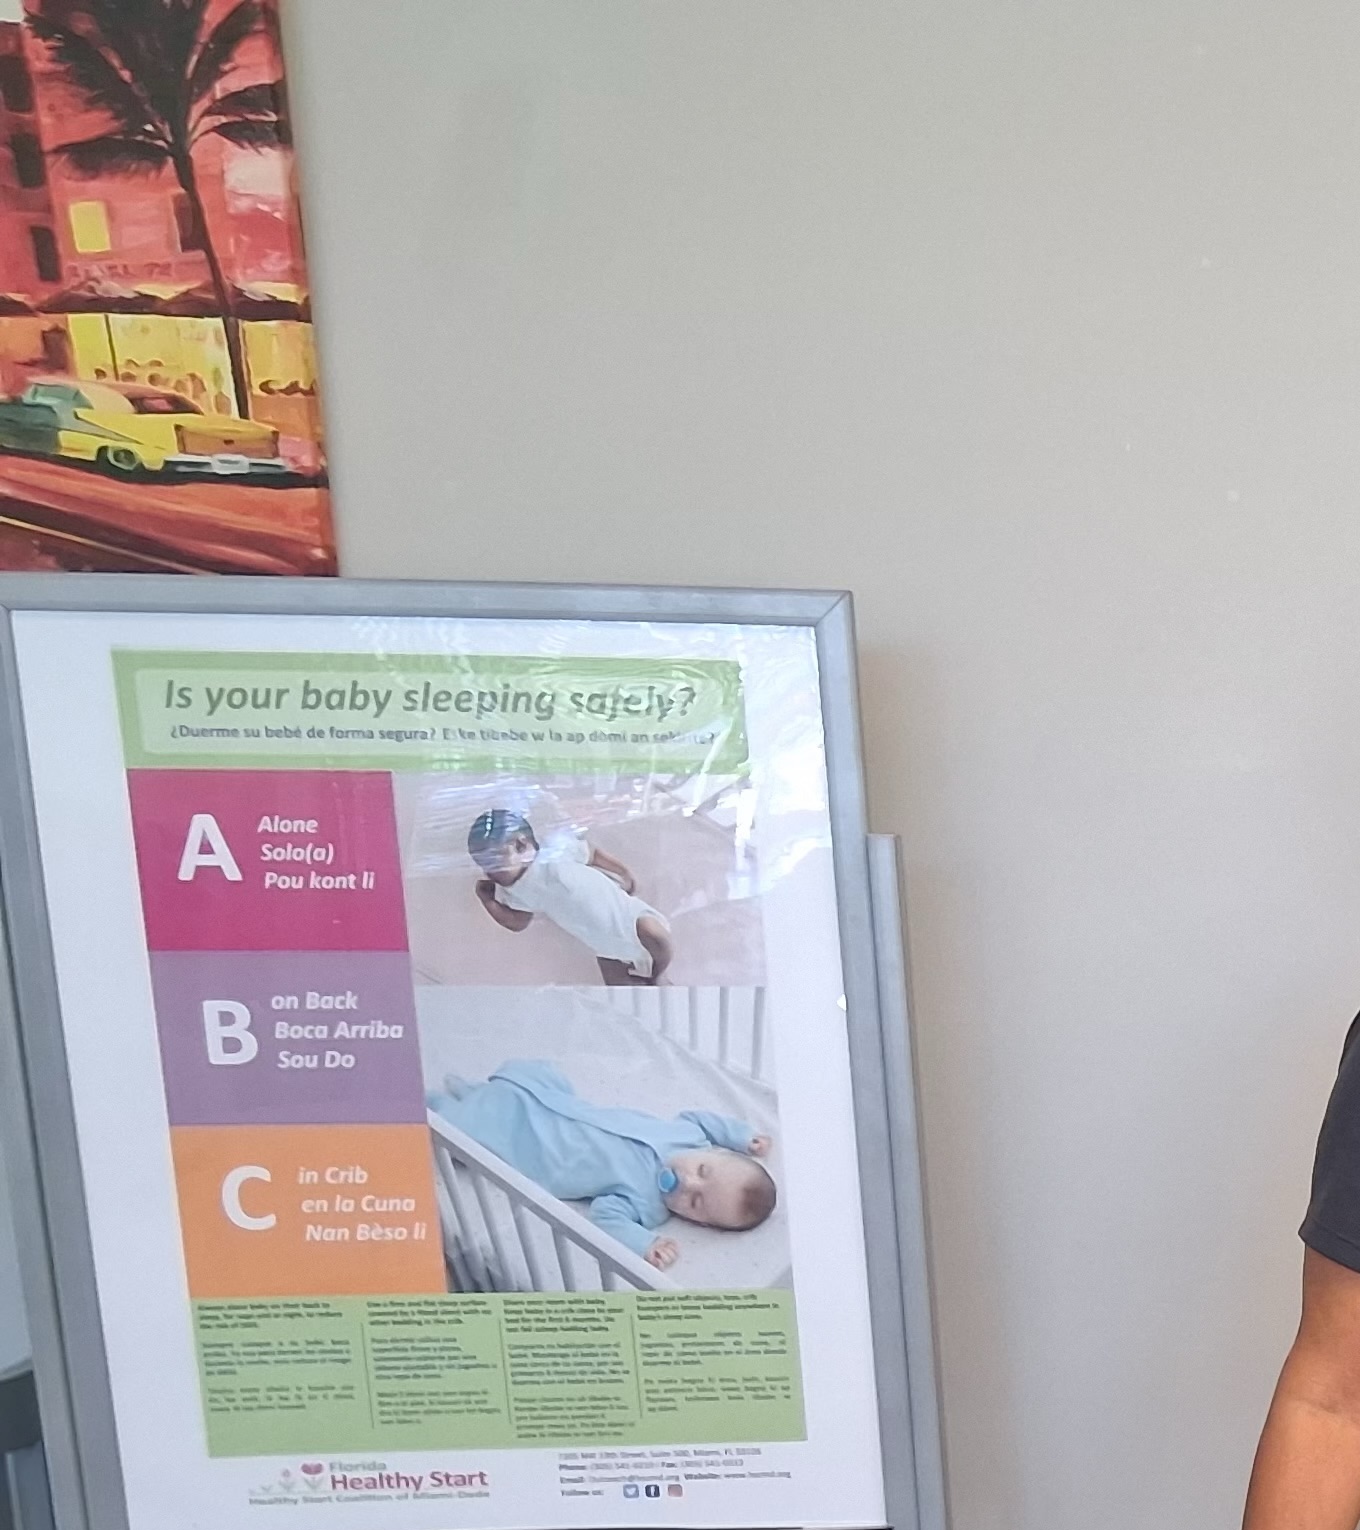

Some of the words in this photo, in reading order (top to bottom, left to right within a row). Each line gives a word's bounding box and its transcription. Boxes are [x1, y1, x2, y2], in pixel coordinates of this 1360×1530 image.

[165, 679, 193, 709] Is
[205, 686, 290, 717] your
[300, 679, 393, 719] baby
[403, 681, 556, 722] sleeping
[570, 684, 697, 723] safely?
[244, 728, 261, 739] su
[265, 725, 302, 739] bebé
[307, 726, 326, 740] de
[329, 726, 374, 740] forma
[378, 728, 436, 743] segura?
[257, 815, 319, 834] Alone
[178, 813, 243, 881] A
[260, 842, 335, 865] Solo(a)
[264, 872, 304, 889] Pou
[309, 871, 357, 889] kont
[362, 871, 375, 889] li
[271, 994, 299, 1010] on
[305, 991, 358, 1010] Back
[203, 1000, 259, 1065] B
[274, 1022, 329, 1039] Boca
[333, 1020, 405, 1039] Arriba
[277, 1050, 318, 1069] Sou
[324, 1051, 356, 1068] Do
[299, 1166, 318, 1184] in
[324, 1165, 368, 1184] Crib
[222, 1165, 277, 1230] C
[301, 1198, 329, 1213] en
[335, 1195, 355, 1213] la
[360, 1195, 416, 1213] Cuna
[305, 1224, 350, 1242] Nan
[356, 1223, 408, 1242] Bèso
[413, 1222, 427, 1241] li
[329, 1461, 387, 1473] Florida
[330, 1472, 424, 1492] Healthy
[429, 1470, 489, 1489] Start
